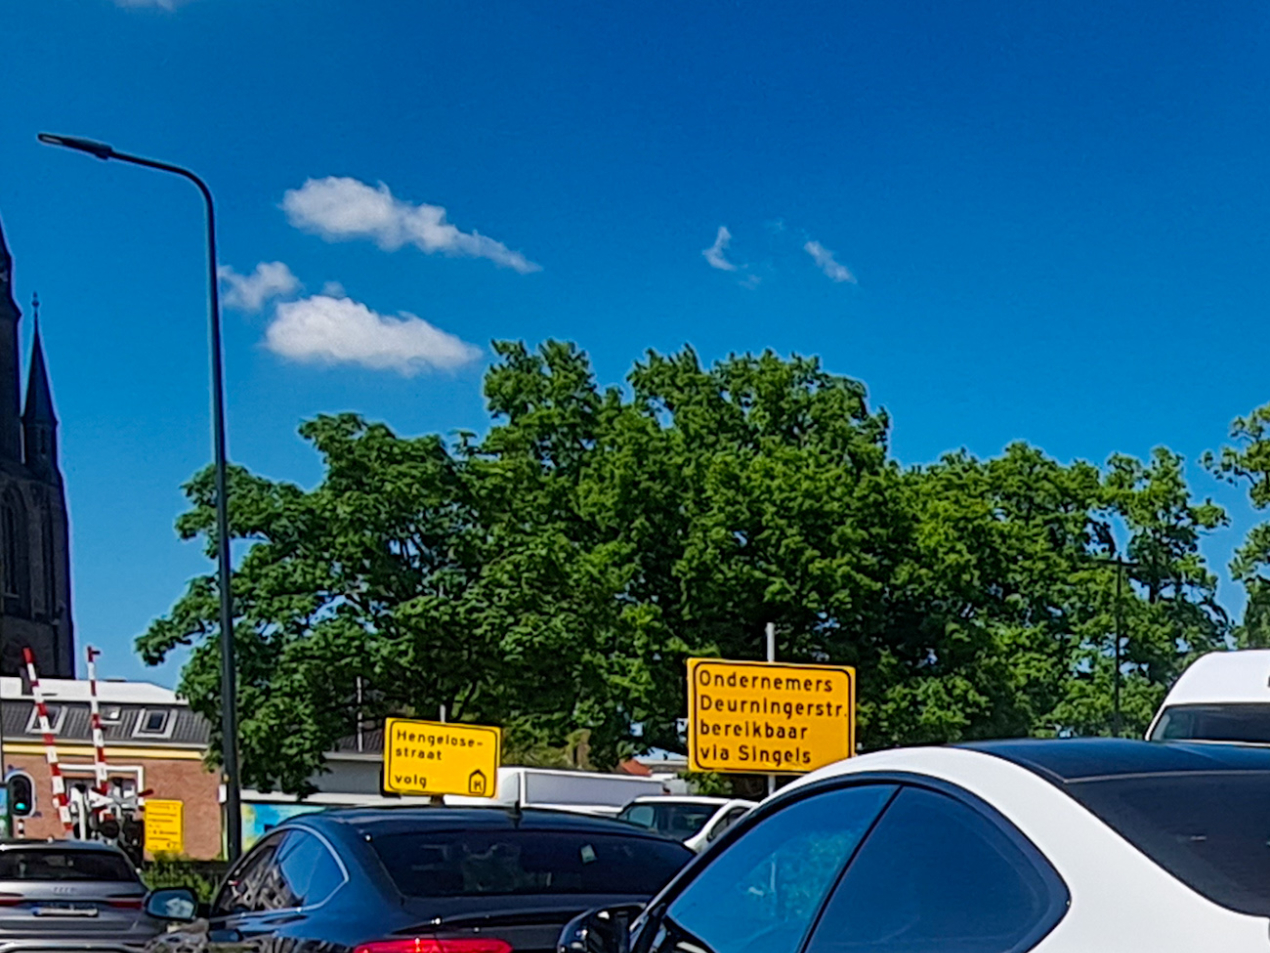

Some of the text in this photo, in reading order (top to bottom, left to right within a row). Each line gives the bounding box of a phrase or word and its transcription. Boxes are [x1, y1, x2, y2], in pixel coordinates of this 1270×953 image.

[699, 669, 833, 692] Ondernemers
[700, 694, 847, 719] Deurningerstr.
[396, 729, 484, 748] Hengelose-
[700, 719, 808, 740] bereikbaar
[395, 747, 442, 760] straat
[700, 744, 812, 767] via Singels
[394, 774, 427, 789] volg
